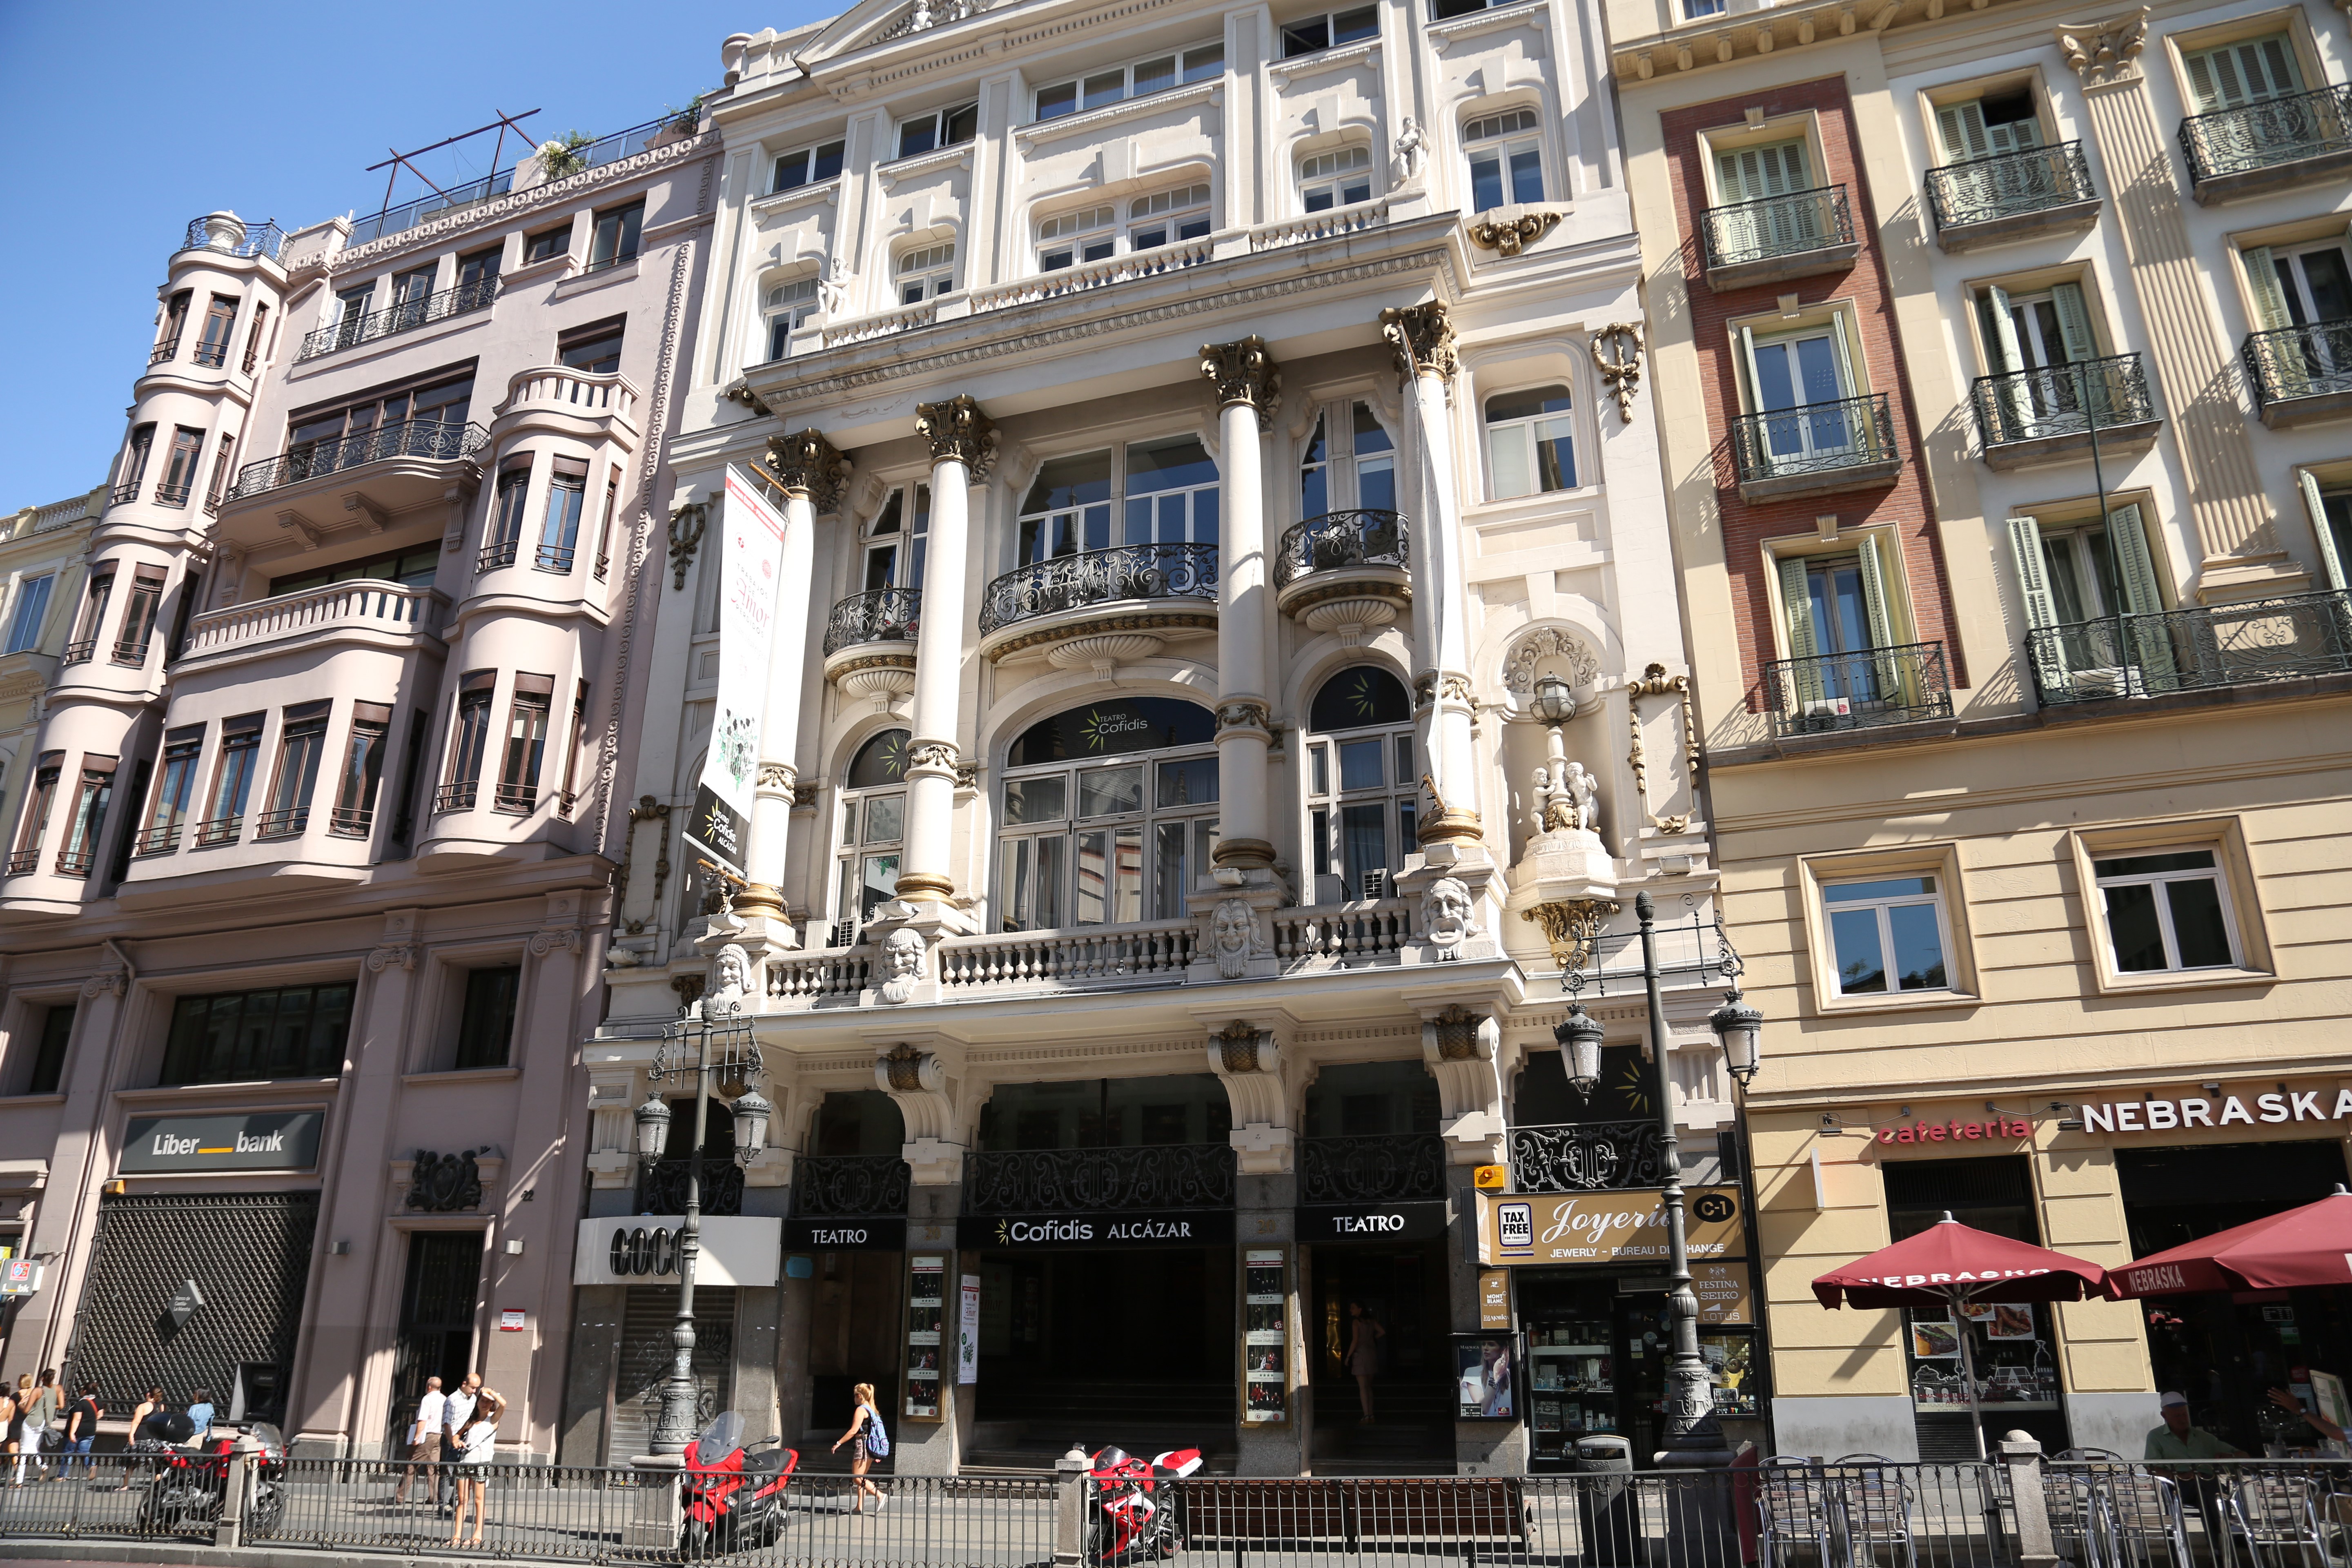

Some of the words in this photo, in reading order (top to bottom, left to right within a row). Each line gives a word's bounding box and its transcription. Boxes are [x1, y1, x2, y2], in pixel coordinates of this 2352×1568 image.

[737, 563, 768, 599] TRABAJOS
[748, 585, 755, 597] DE
[731, 577, 769, 627] Amor
[736, 604, 764, 638] PERDIDOS
[1100, 714, 1126, 722] TEATRO
[1099, 719, 1148, 734] Cofidis
[717, 810, 729, 824] TEATRO
[714, 818, 736, 842] Cofidis
[717, 836, 737, 855] ALCÁZAR
[1878, 1116, 2029, 1144] cafetería
[1332, 1214, 1405, 1232] TEATRO
[1504, 1212, 1525, 1223] TAX
[1011, 1219, 1094, 1241] Cofidis
[1107, 1219, 1192, 1238] ALCÁZAR
[1257, 1219, 1276, 1234] 20
[1503, 1223, 1528, 1235] FREE
[811, 1229, 867, 1243] TEATRO
[1550, 1247, 1597, 1258] JEWERLY
[1612, 1245, 1655, 1256] BUREAU
[1685, 1243, 1724, 1254] HANGE
[1699, 1280, 1739, 1289] FESTINA
[2128, 1265, 2186, 1292] NEBRASKA
[1700, 1291, 1738, 1300] SEIKO
[1703, 1312, 1740, 1321] LOTUS
